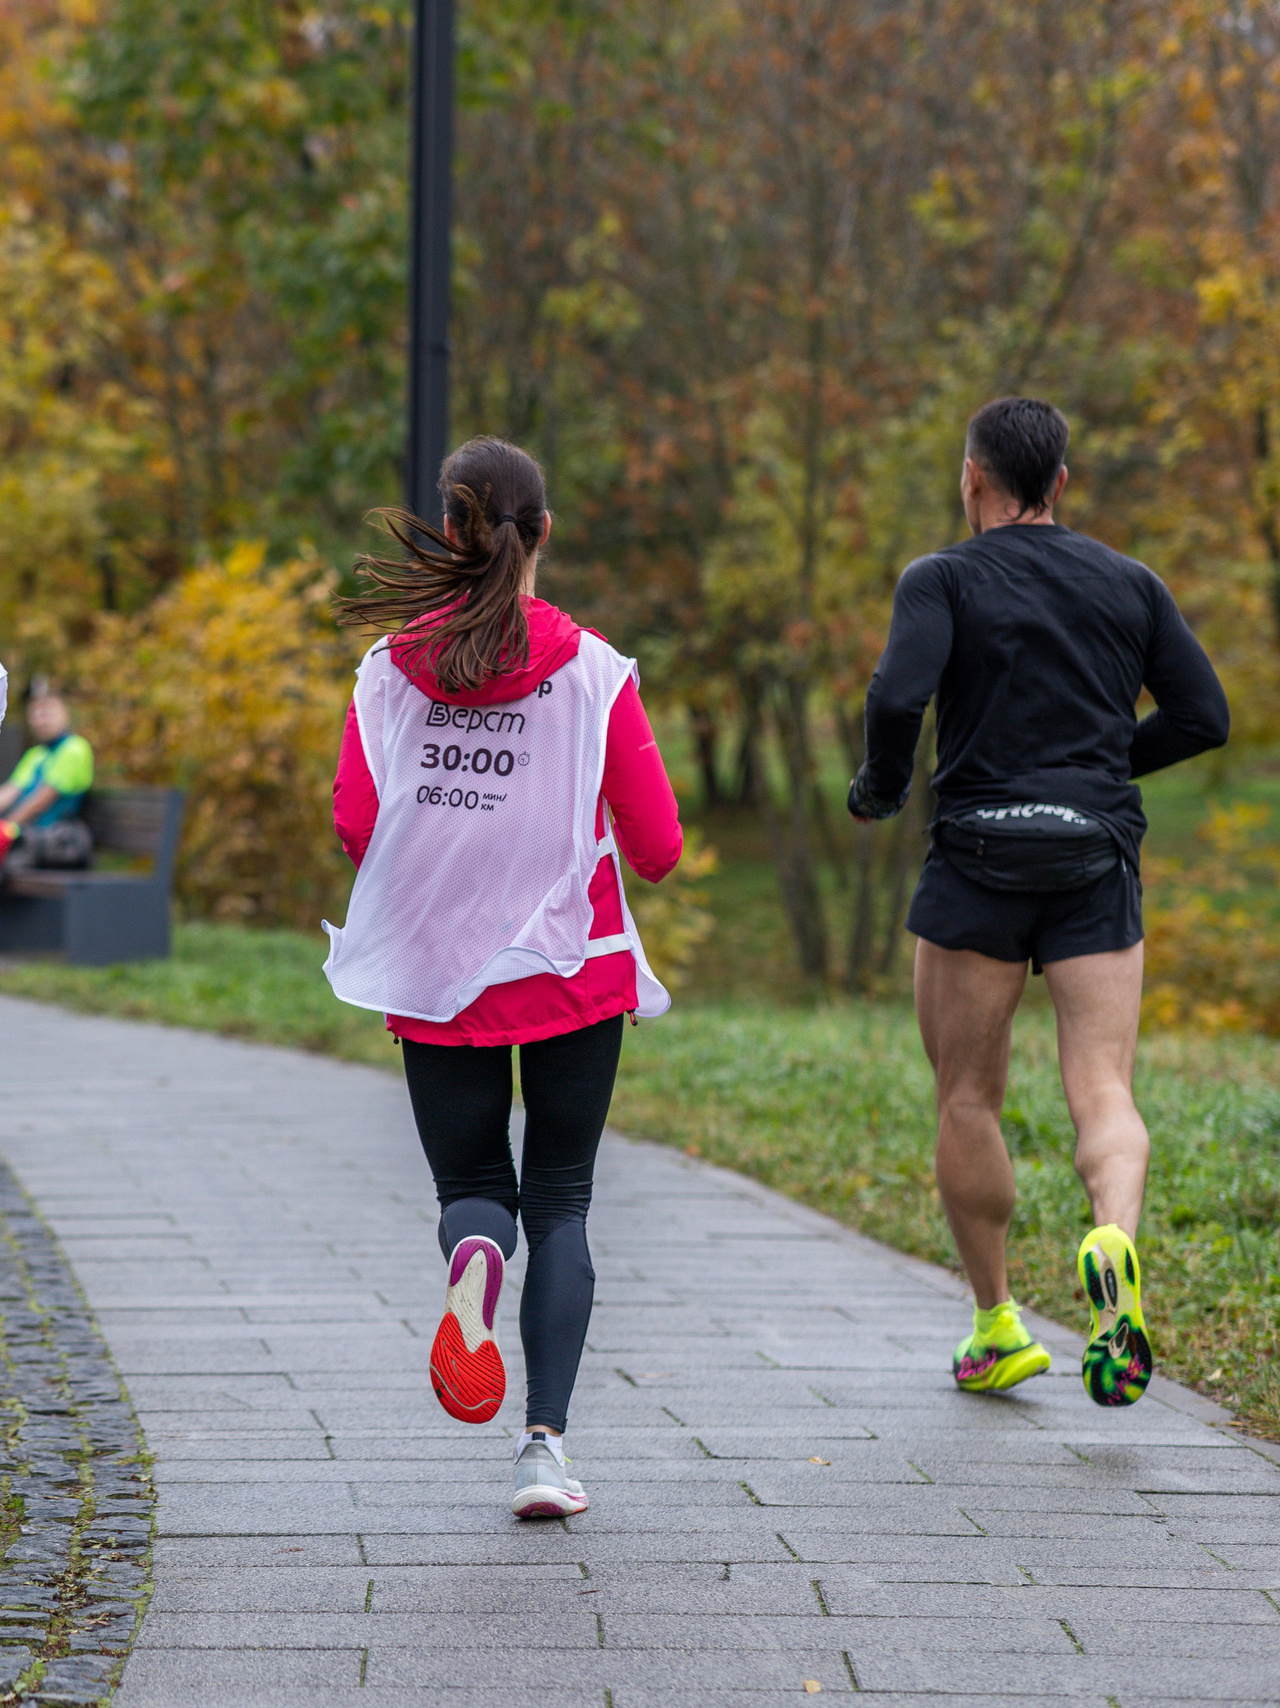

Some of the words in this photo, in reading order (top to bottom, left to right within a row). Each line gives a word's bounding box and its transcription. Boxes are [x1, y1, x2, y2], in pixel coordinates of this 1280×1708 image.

[420, 743, 515, 777] 30:00
[416, 785, 479, 810] 06:00
[480, 802, 495, 811] км
